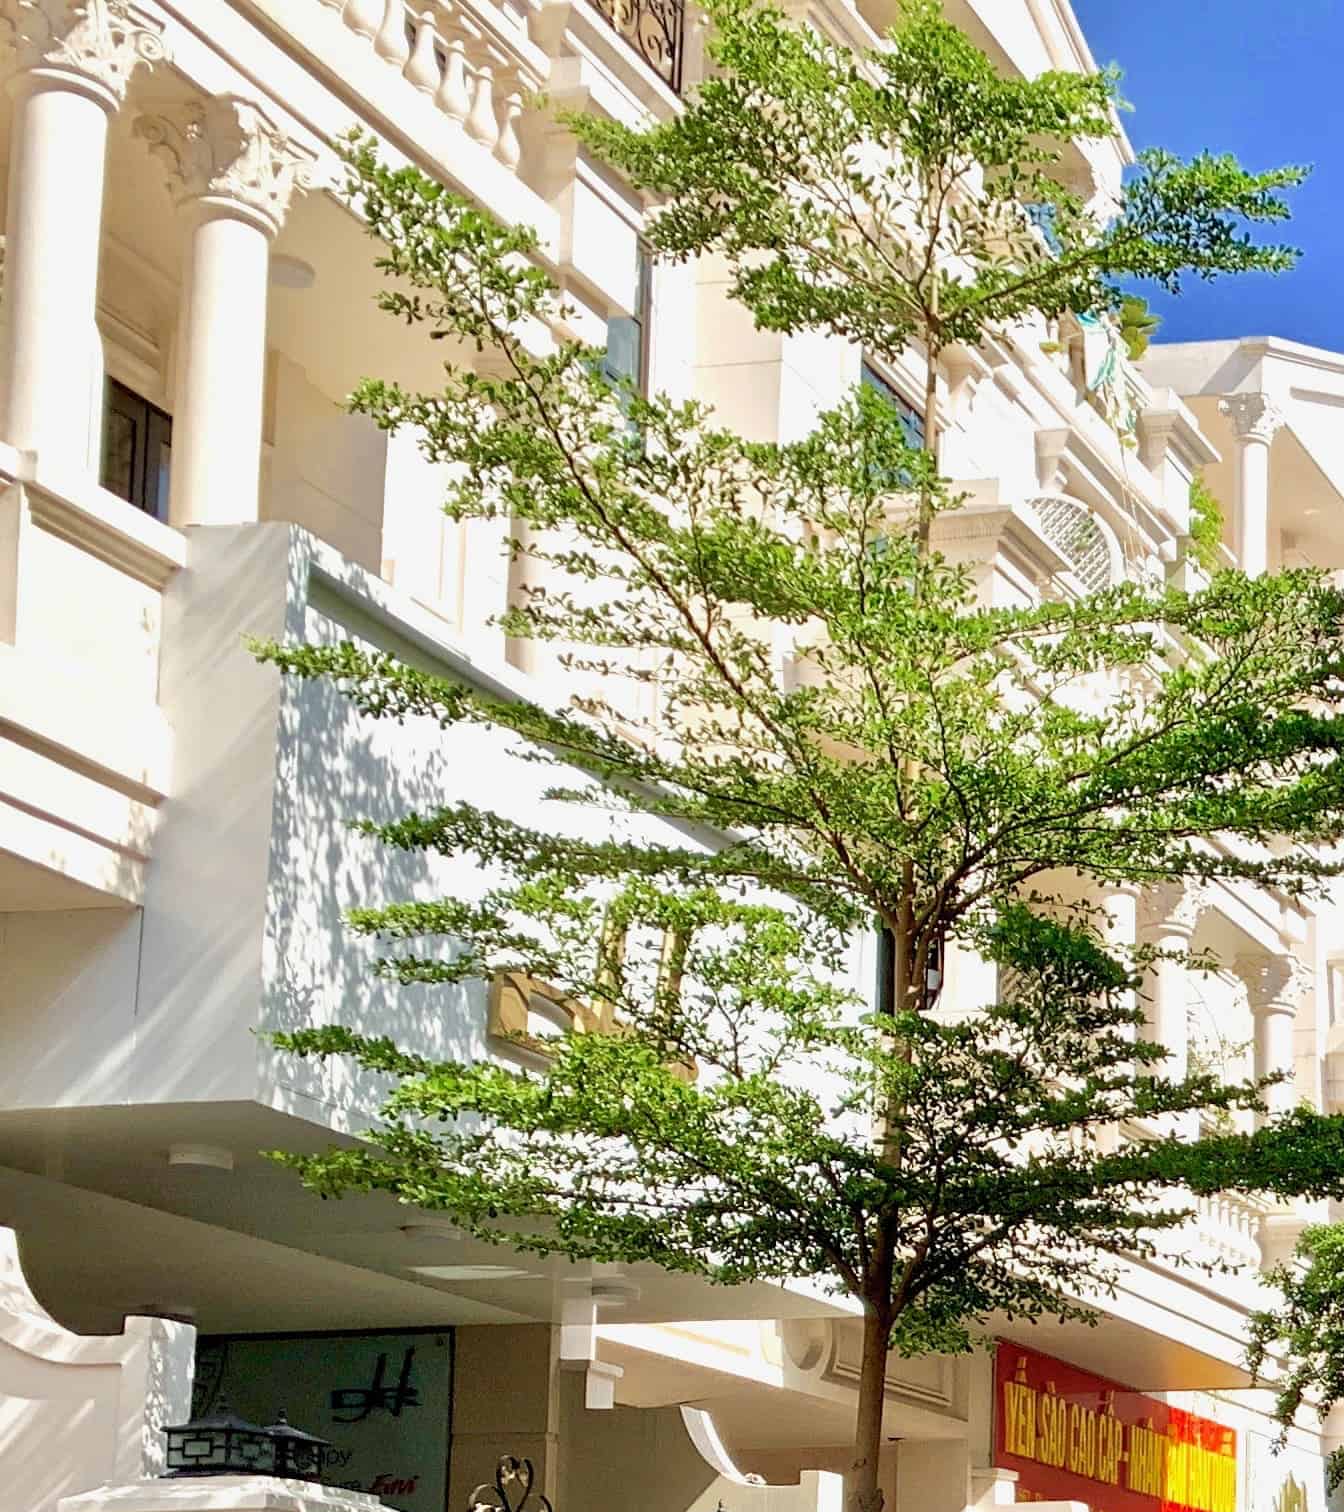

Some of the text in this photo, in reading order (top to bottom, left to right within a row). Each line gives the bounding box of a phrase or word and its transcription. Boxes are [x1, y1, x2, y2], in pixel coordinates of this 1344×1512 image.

[1005, 1357, 1036, 1459] YẾN
[1041, 1381, 1066, 1467] SÀO
[1070, 1403, 1095, 1478] CAO
[1099, 1390, 1123, 1485] CẤP
